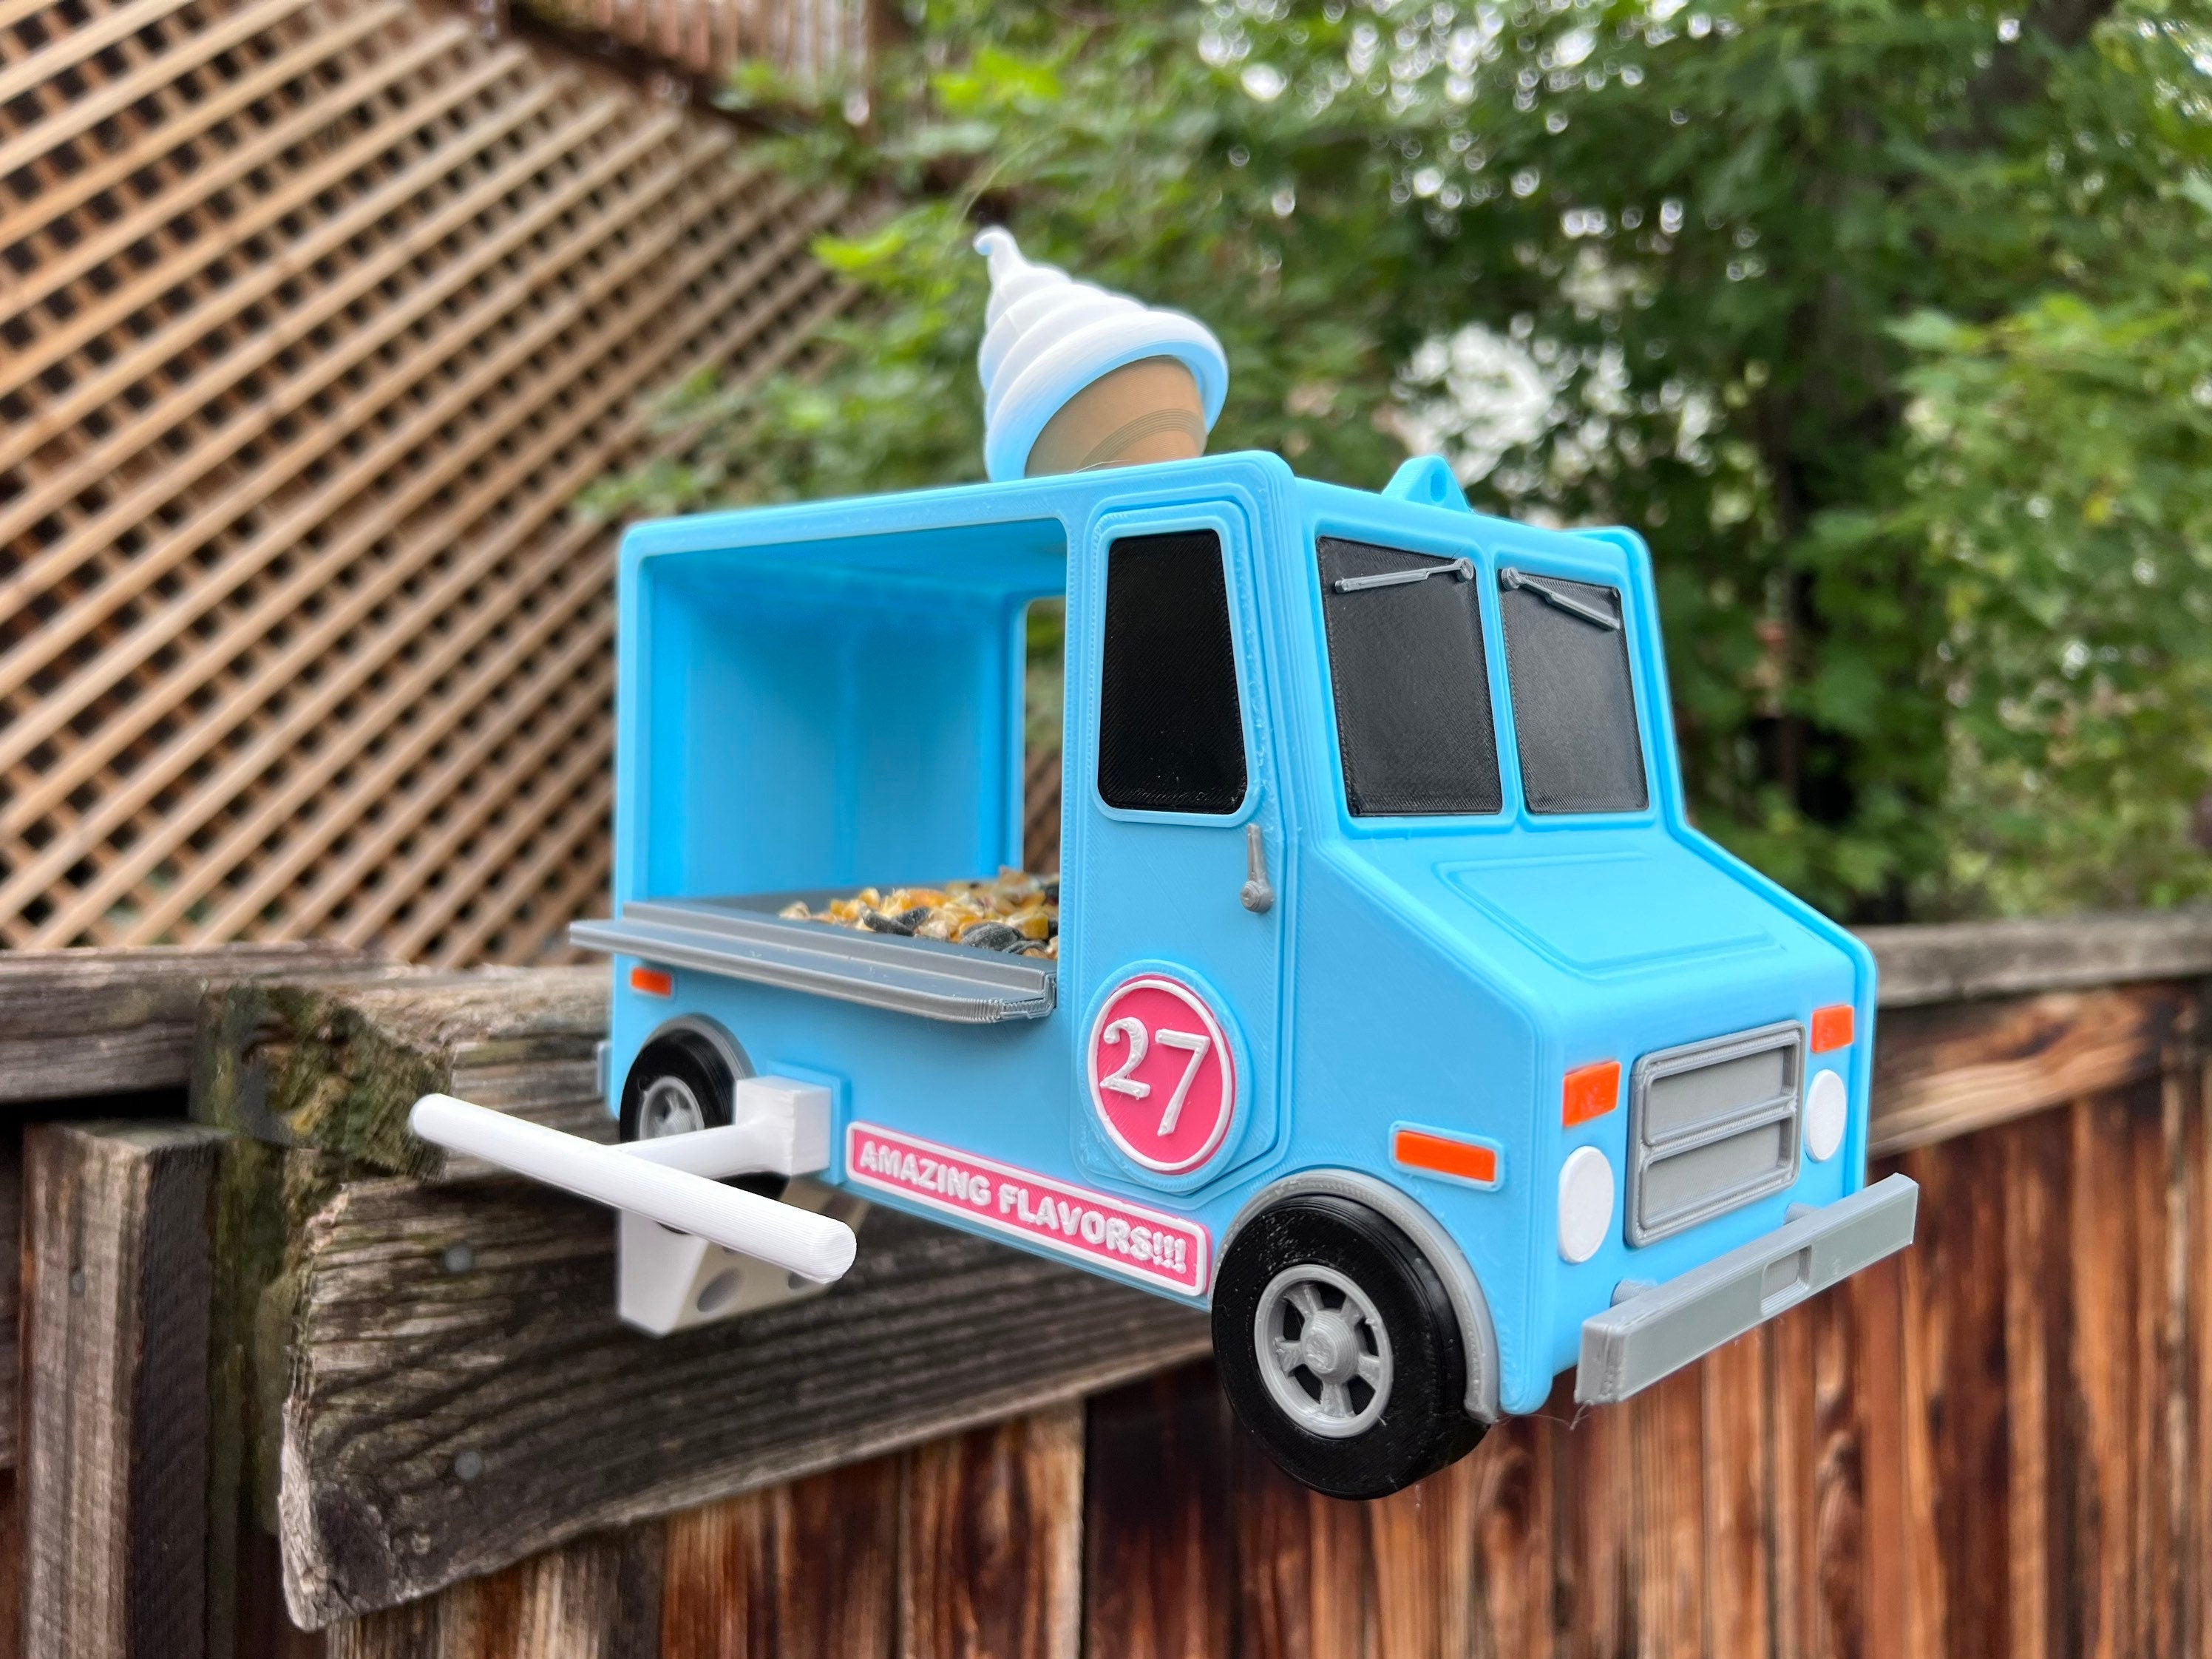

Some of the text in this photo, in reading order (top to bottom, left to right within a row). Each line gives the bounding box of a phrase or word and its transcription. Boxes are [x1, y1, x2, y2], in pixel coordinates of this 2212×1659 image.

[1099, 1017, 1210, 1136] 27
[860, 1141, 1187, 1274] AMAZING FLAVORS!!!
